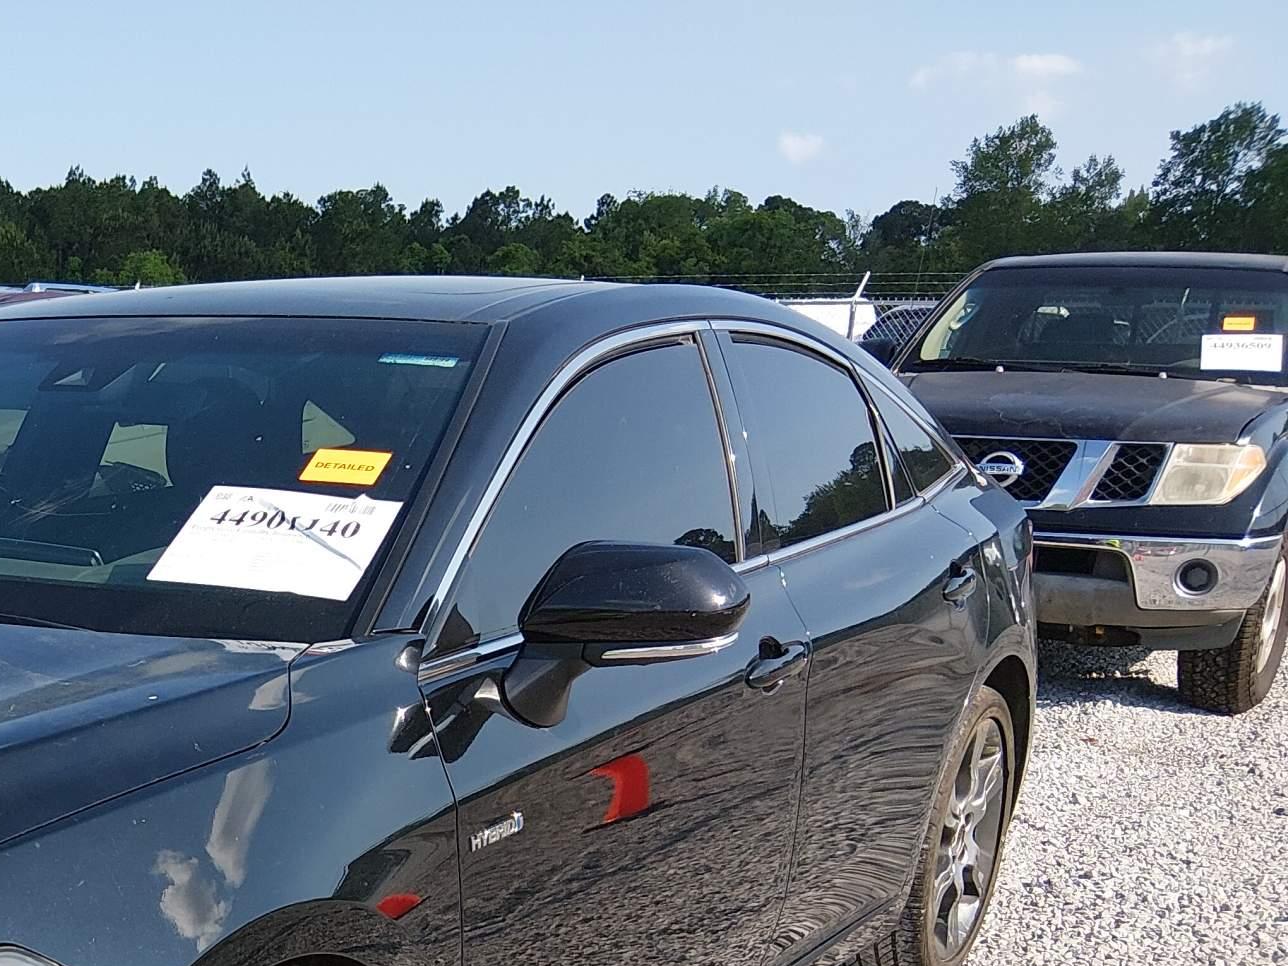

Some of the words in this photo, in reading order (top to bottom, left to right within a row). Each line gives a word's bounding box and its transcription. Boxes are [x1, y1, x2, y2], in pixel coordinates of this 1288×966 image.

[314, 461, 375, 472] DETAILED
[979, 465, 1017, 473] NISSAN
[210, 508, 361, 539] 44901140
[471, 818, 516, 853] HYBRID
